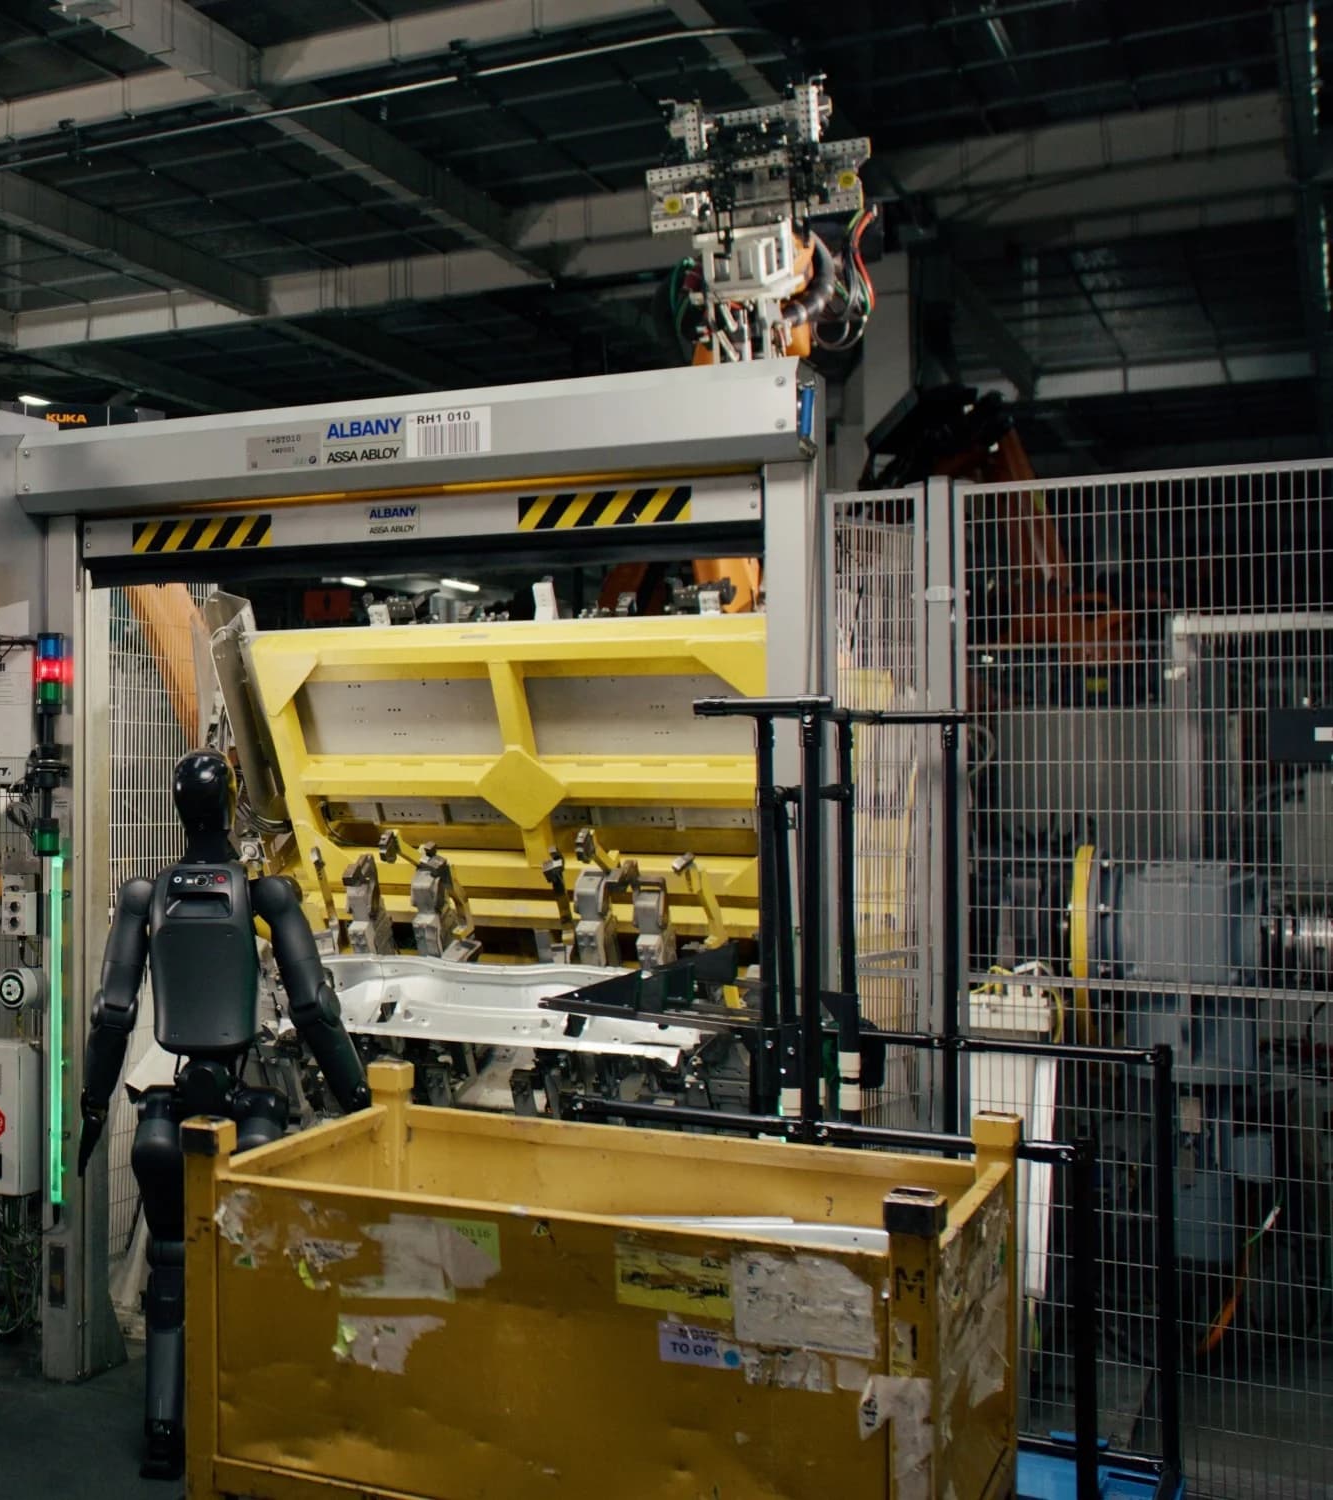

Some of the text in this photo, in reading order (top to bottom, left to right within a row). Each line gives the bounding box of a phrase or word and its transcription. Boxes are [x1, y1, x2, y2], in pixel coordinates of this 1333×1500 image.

[45, 412, 88, 424] KUKA
[448, 411, 471, 422] 010
[326, 417, 402, 440] ALBANY
[327, 447, 400, 464] ASSA ABLOY
[369, 505, 417, 520] ALBANY
[896, 1267, 926, 1304] M
[670, 1341, 691, 1356] TO
